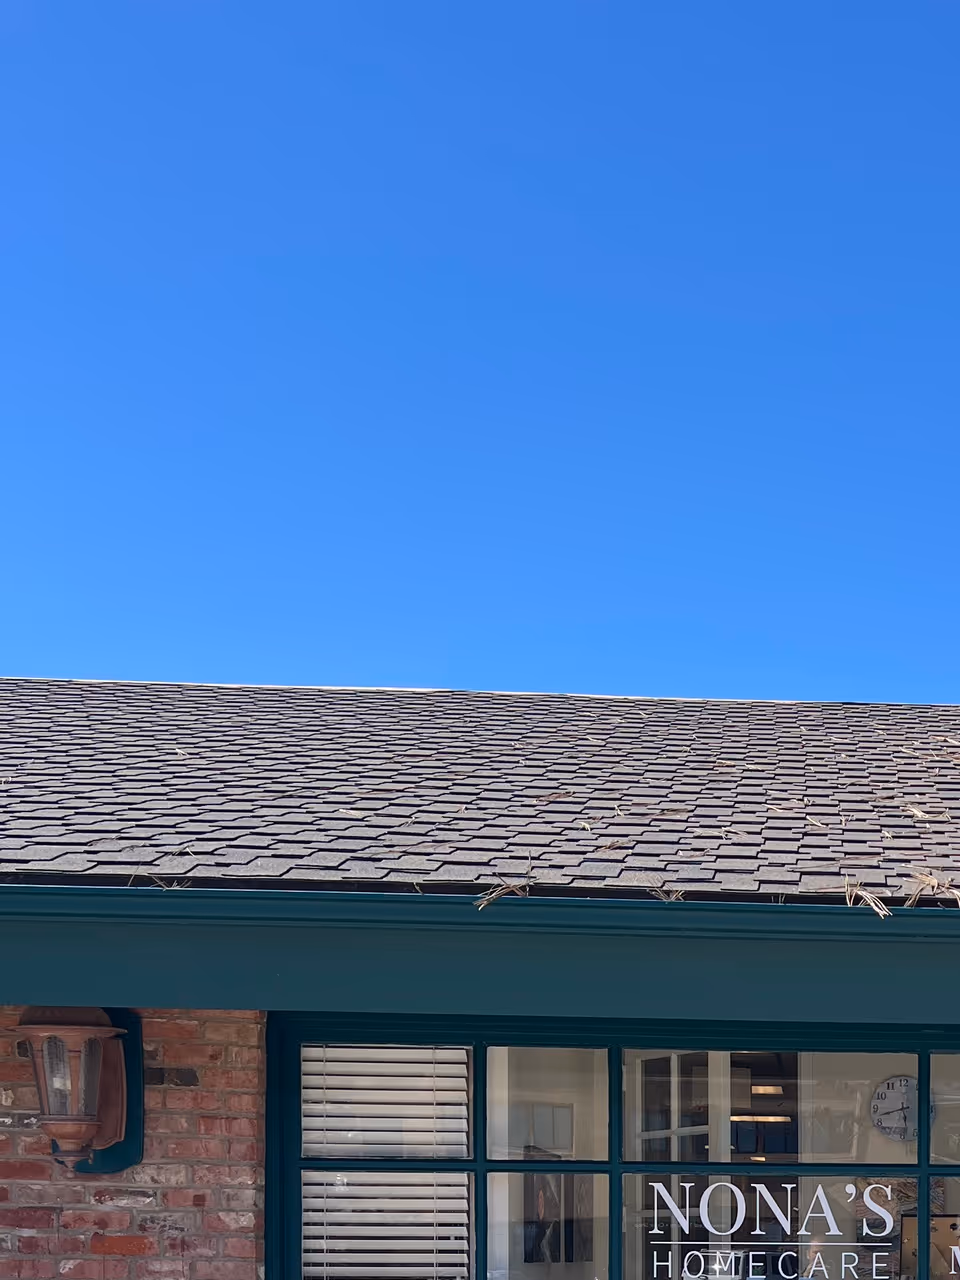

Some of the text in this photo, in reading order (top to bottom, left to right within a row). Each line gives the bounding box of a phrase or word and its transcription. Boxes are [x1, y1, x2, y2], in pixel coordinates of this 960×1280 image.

[886, 1082, 895, 1090] 11
[899, 1079, 909, 1087] 12
[876, 1092, 887, 1100] 10
[872, 1104, 879, 1113] 9
[648, 1182, 894, 1237] NONA'S
